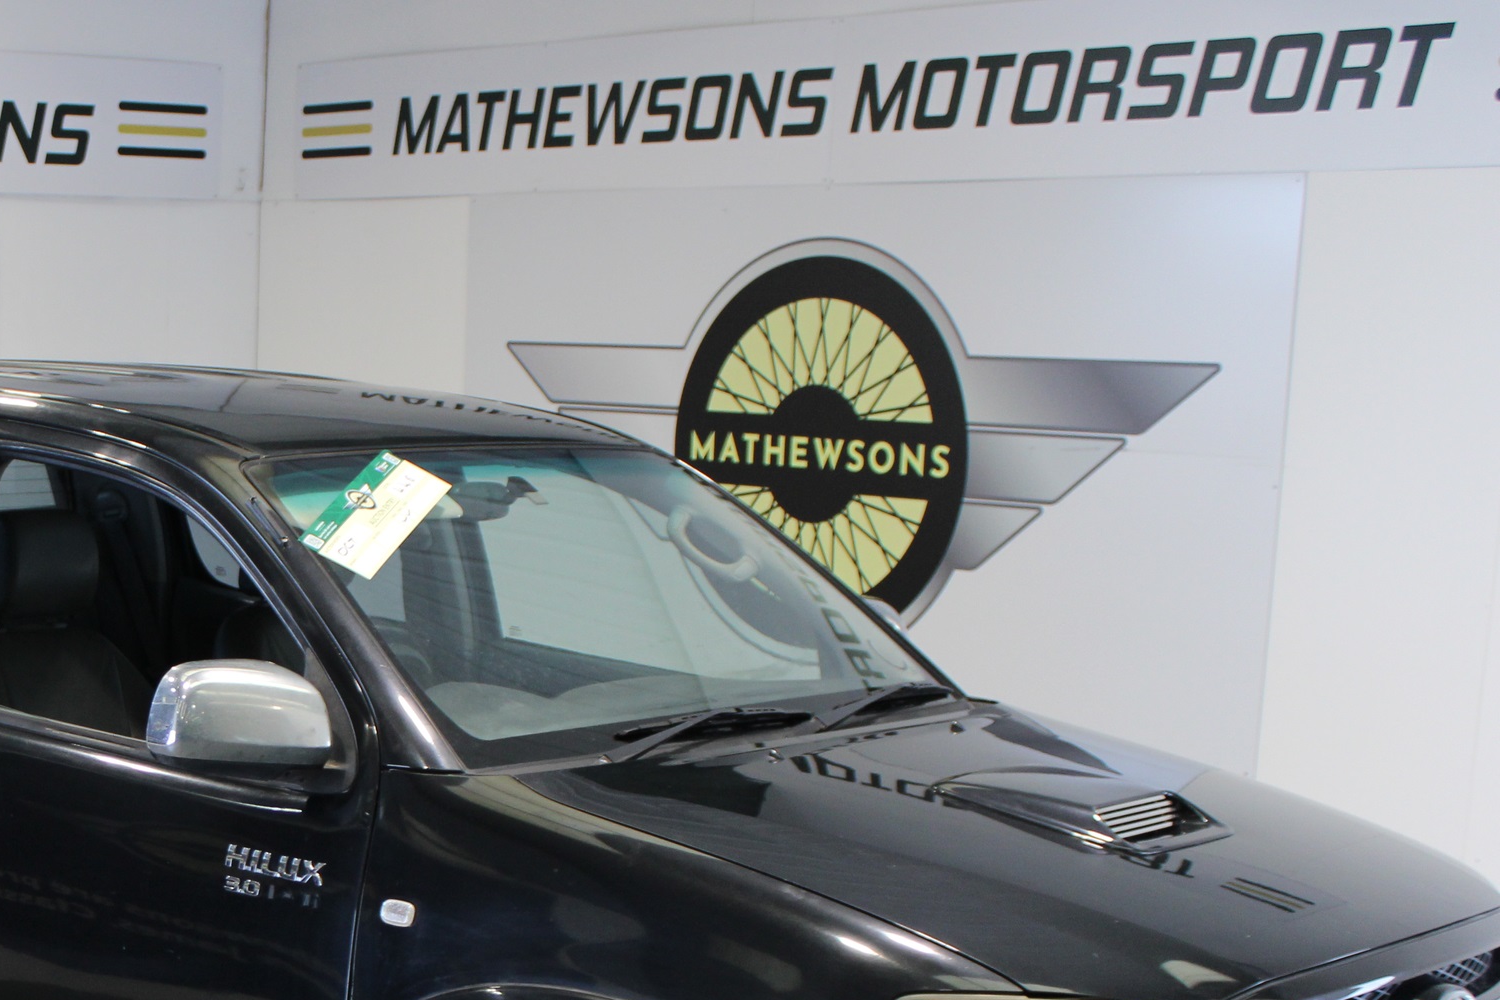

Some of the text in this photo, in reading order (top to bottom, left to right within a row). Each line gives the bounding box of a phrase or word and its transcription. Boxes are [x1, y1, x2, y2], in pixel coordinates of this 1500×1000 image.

[393, 21, 1457, 156] MATHEWSONS MOTORSPORT
[688, 430, 952, 480] MATHEWSONS
[224, 843, 327, 887] HILUX
